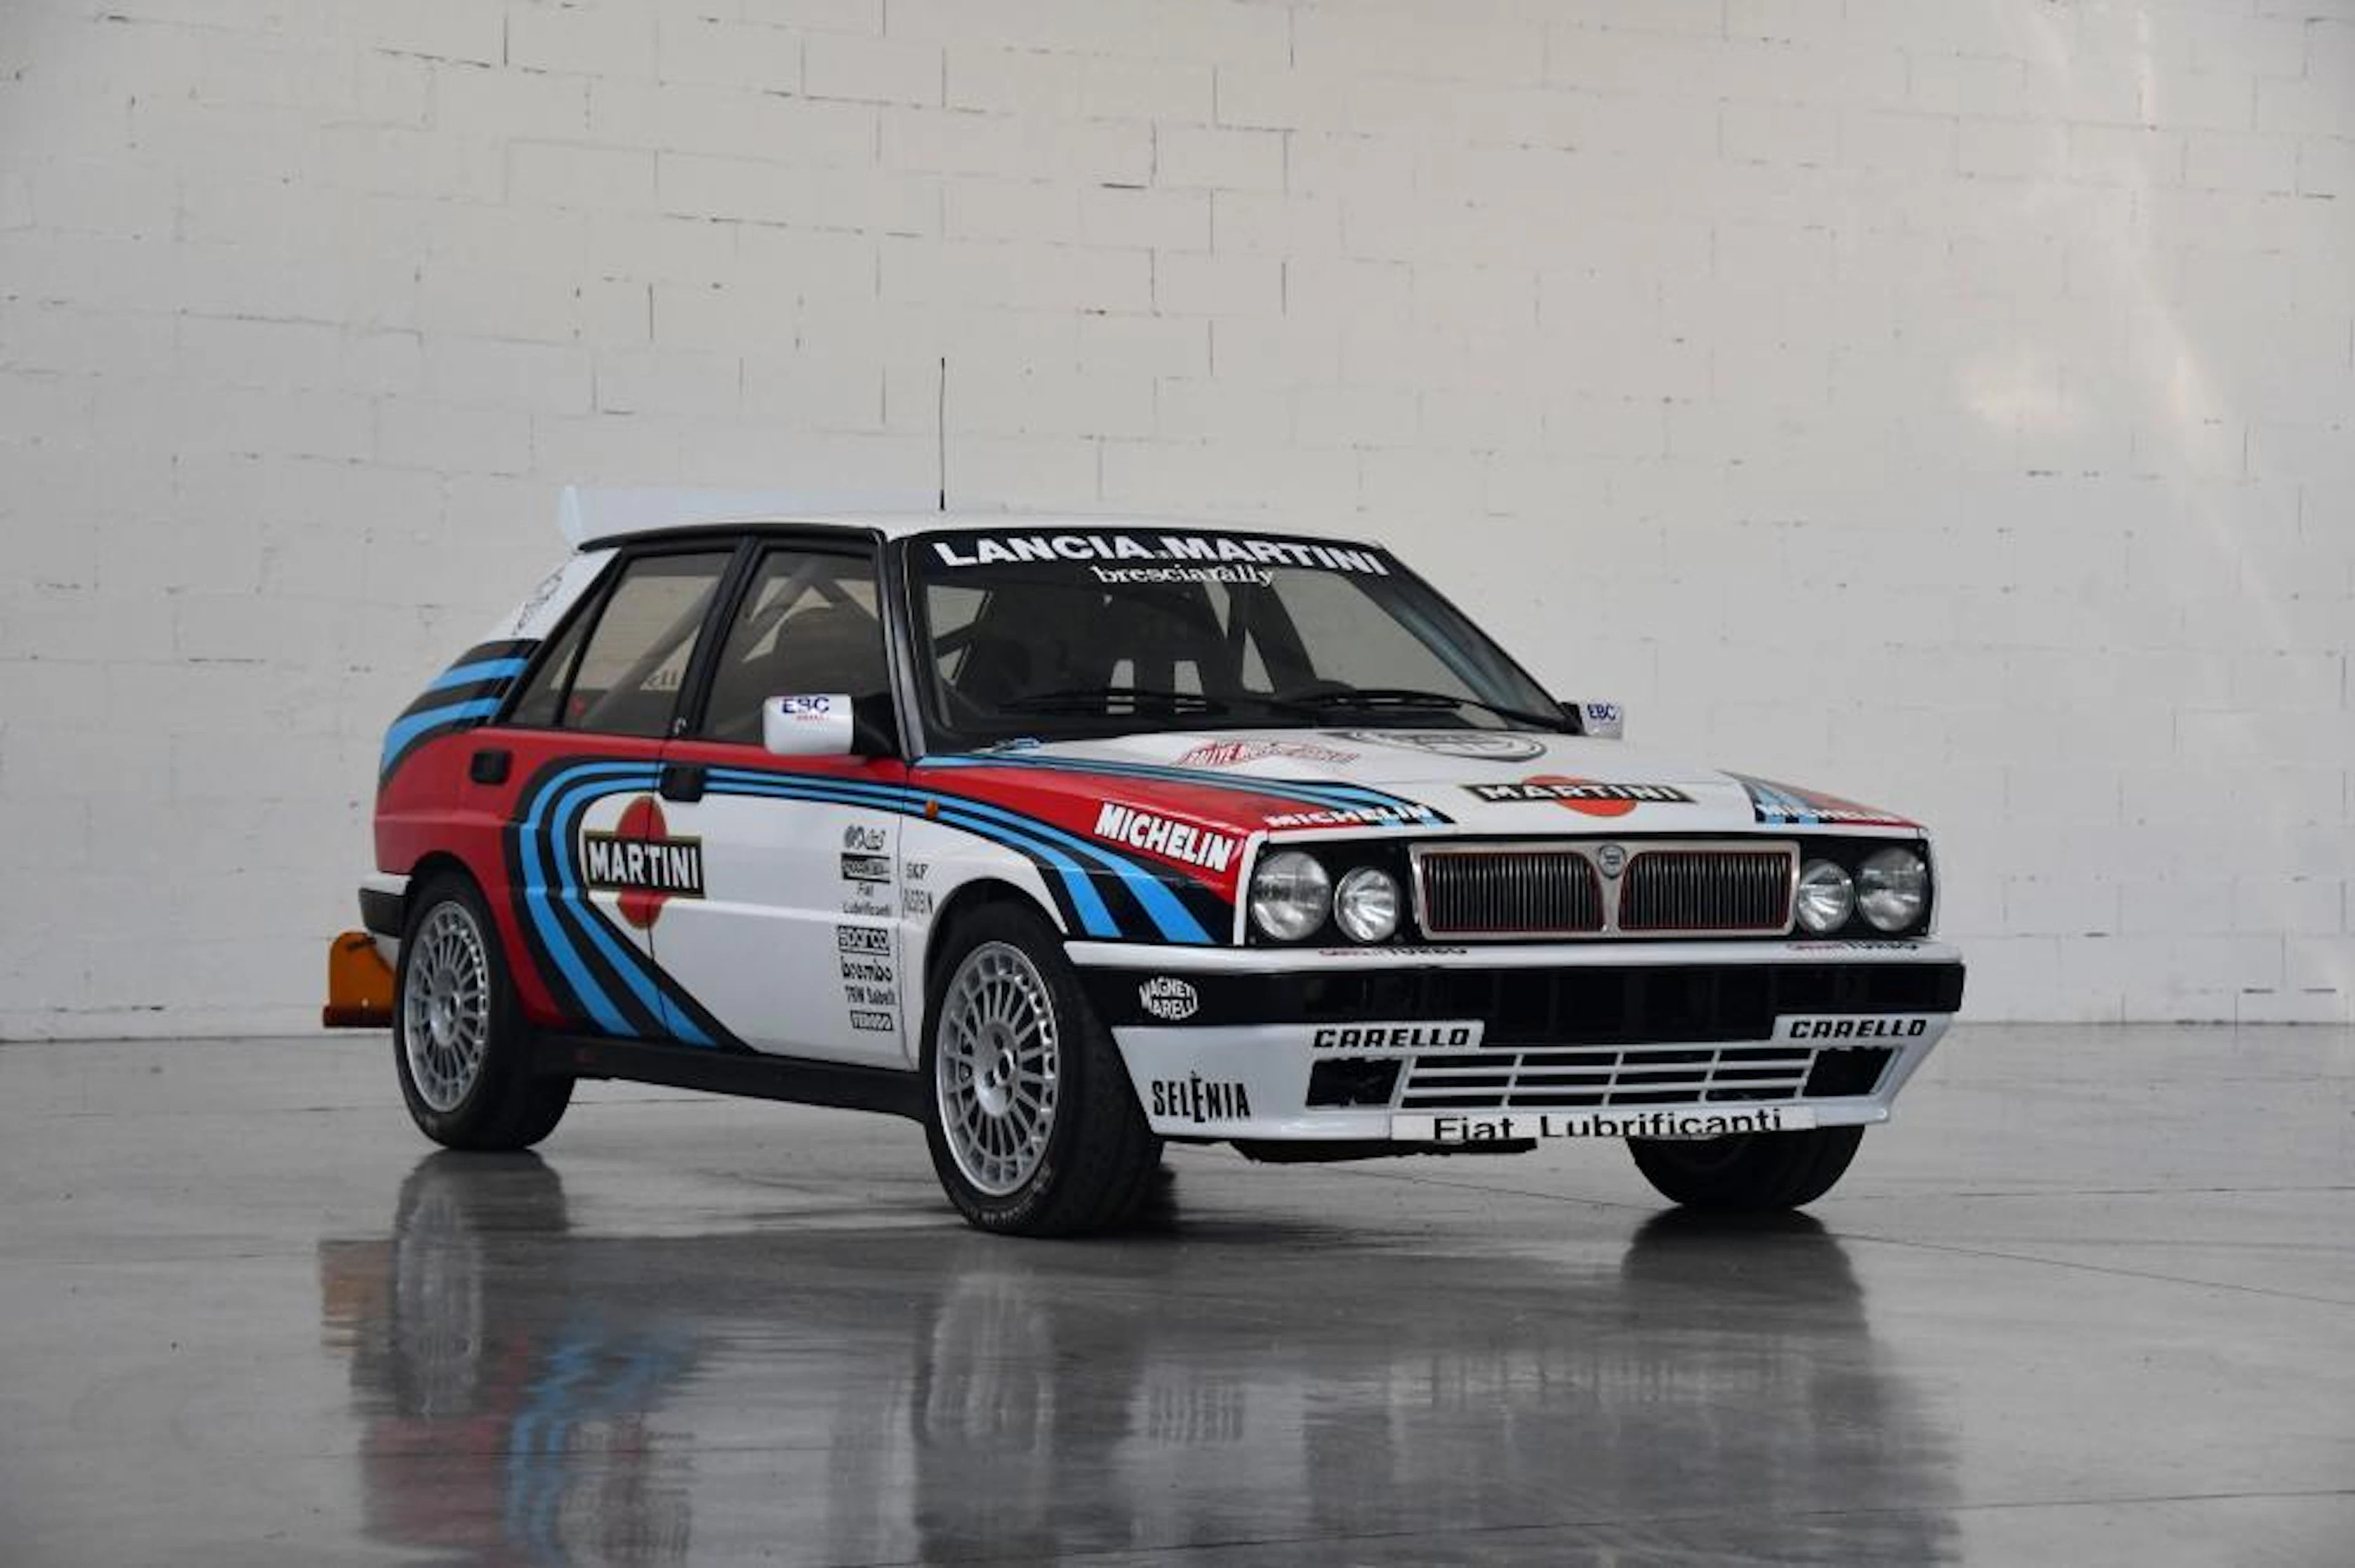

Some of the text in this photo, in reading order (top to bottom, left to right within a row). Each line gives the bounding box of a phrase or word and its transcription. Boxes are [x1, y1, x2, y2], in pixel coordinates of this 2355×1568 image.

[1477, 782, 1680, 800] MARTINI
[1262, 804, 1435, 828] MICHELIN
[1093, 803, 1235, 873] MICHELIN
[587, 840, 699, 890] MARTINI
[841, 955, 893, 982] brembo
[1314, 1028, 1469, 1047] CARELLO
[1790, 1019, 1927, 1038] CARELLO
[1433, 1108, 1781, 1141] Fiat Lubrificanti
